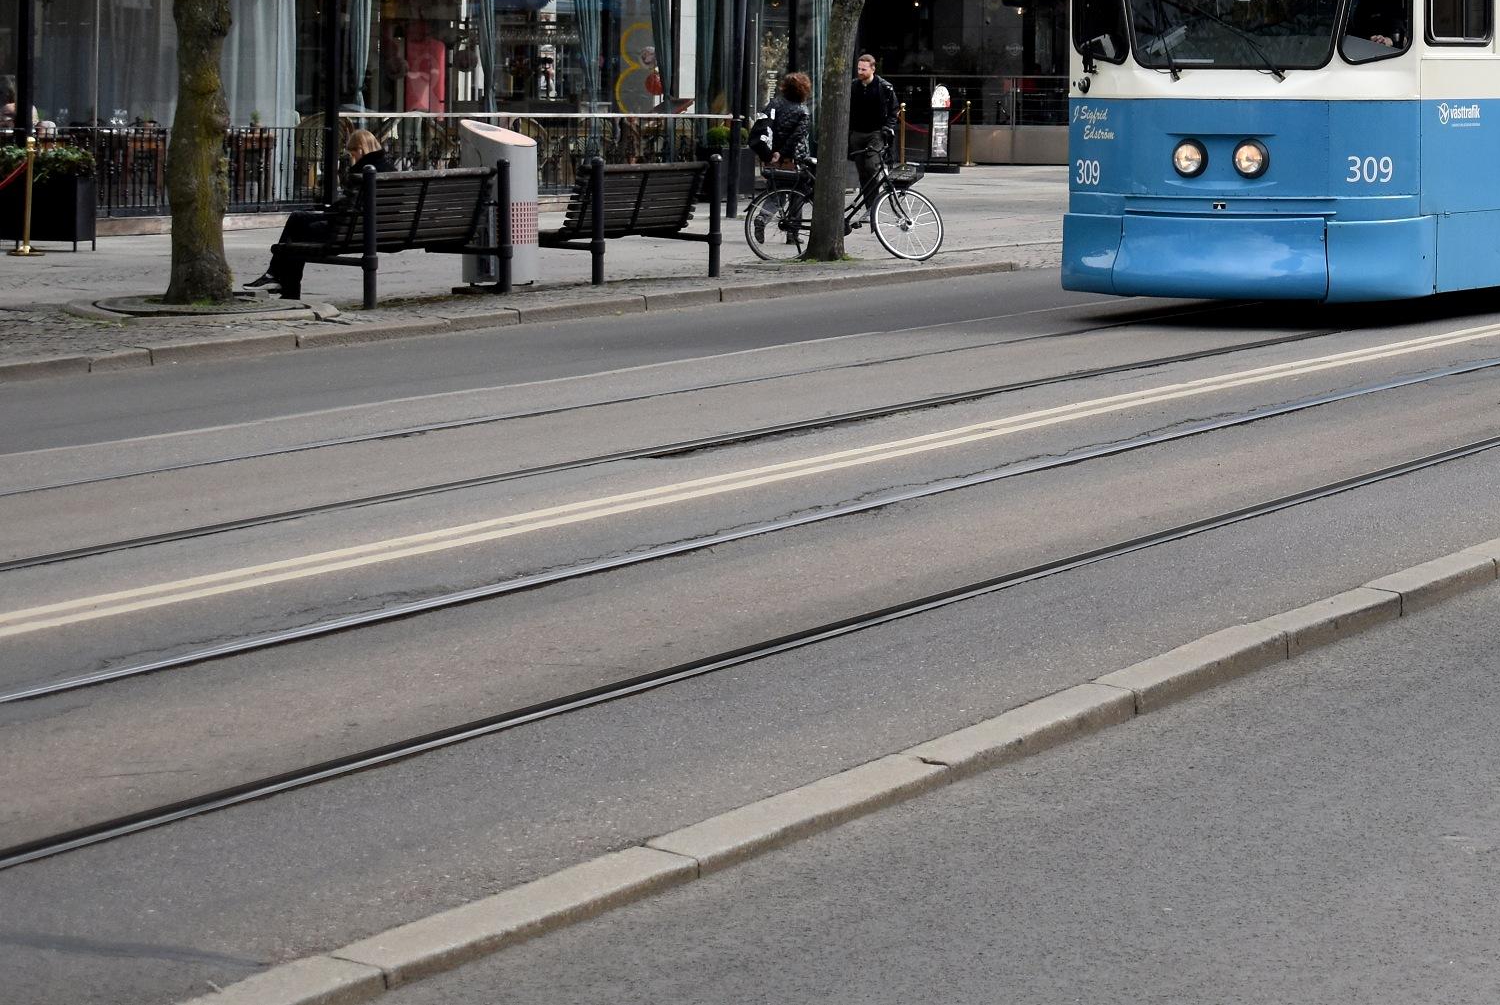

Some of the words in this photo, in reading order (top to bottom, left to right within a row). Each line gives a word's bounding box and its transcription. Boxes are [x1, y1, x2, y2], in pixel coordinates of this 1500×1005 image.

[1080, 105, 1108, 124] Sigfrid
[1450, 104, 1480, 119] västtrafik
[1083, 125, 1115, 140] Edström
[1076, 159, 1100, 185] 309
[1346, 155, 1393, 183] 309
